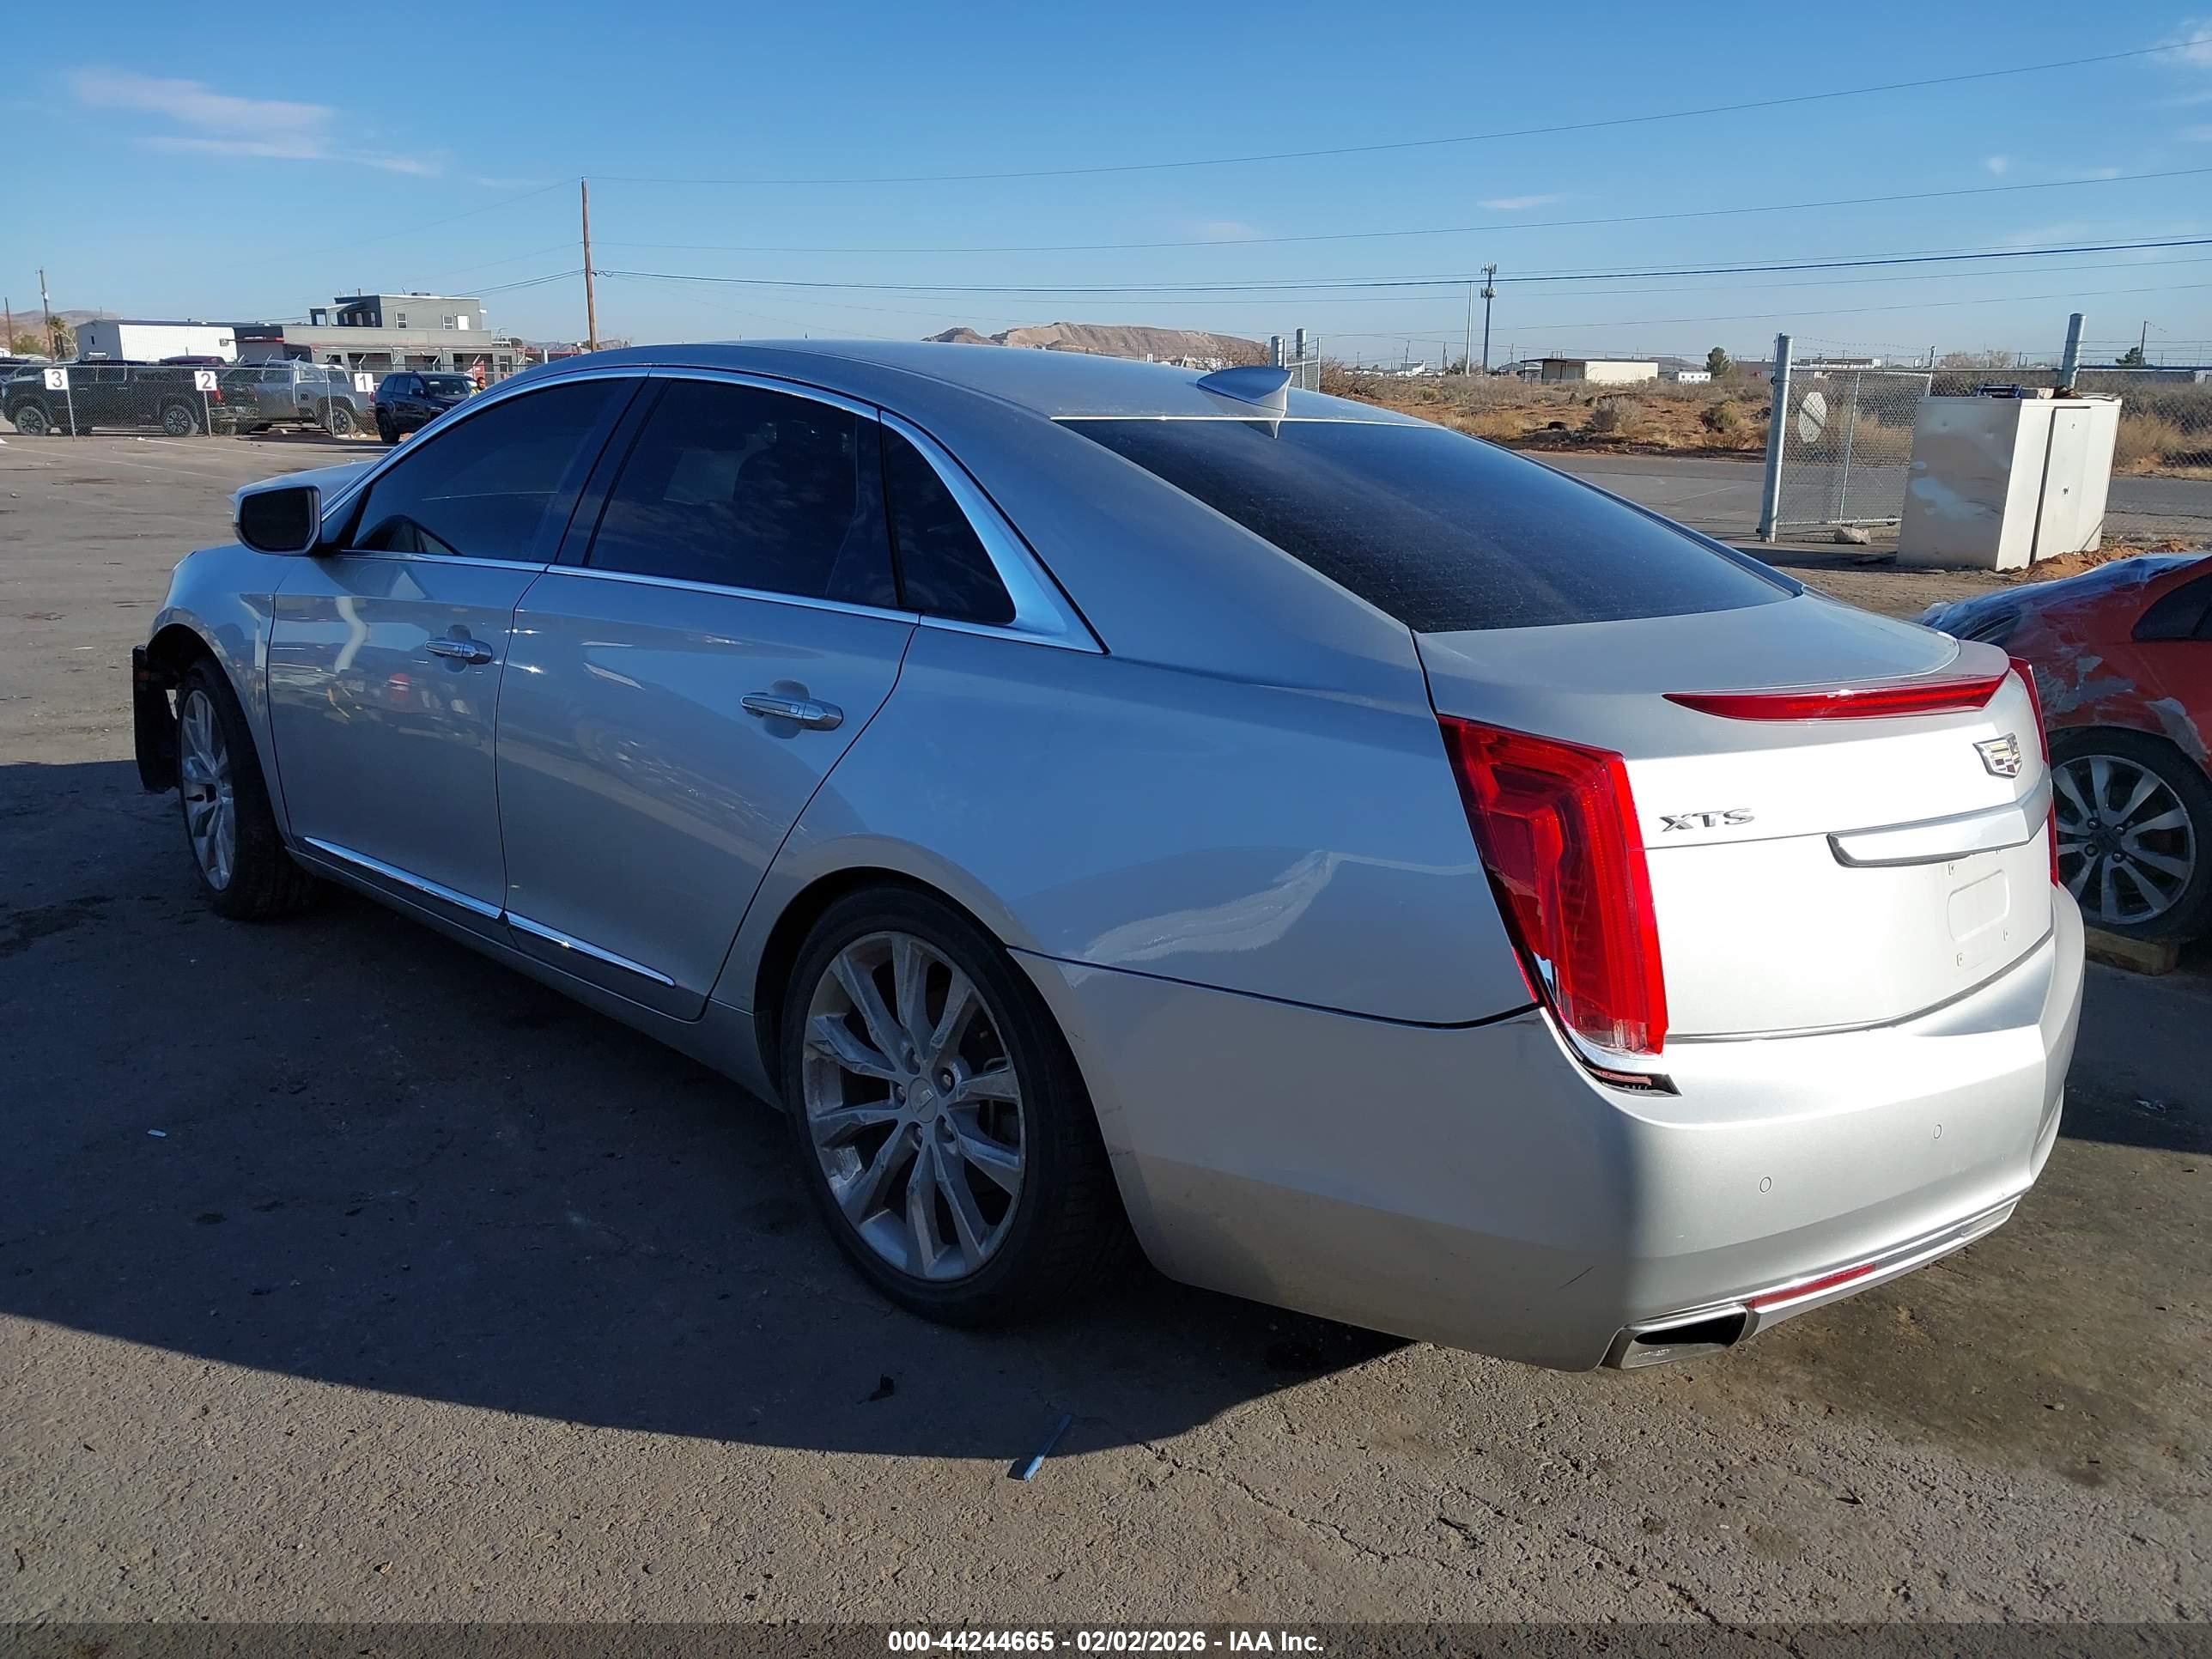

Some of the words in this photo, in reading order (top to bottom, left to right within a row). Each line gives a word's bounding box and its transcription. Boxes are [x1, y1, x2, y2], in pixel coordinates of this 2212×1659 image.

[52, 370, 63, 388] 3
[201, 372, 212, 389] 2
[359, 374, 367, 391] 1
[1659, 808, 1755, 832] XTS
